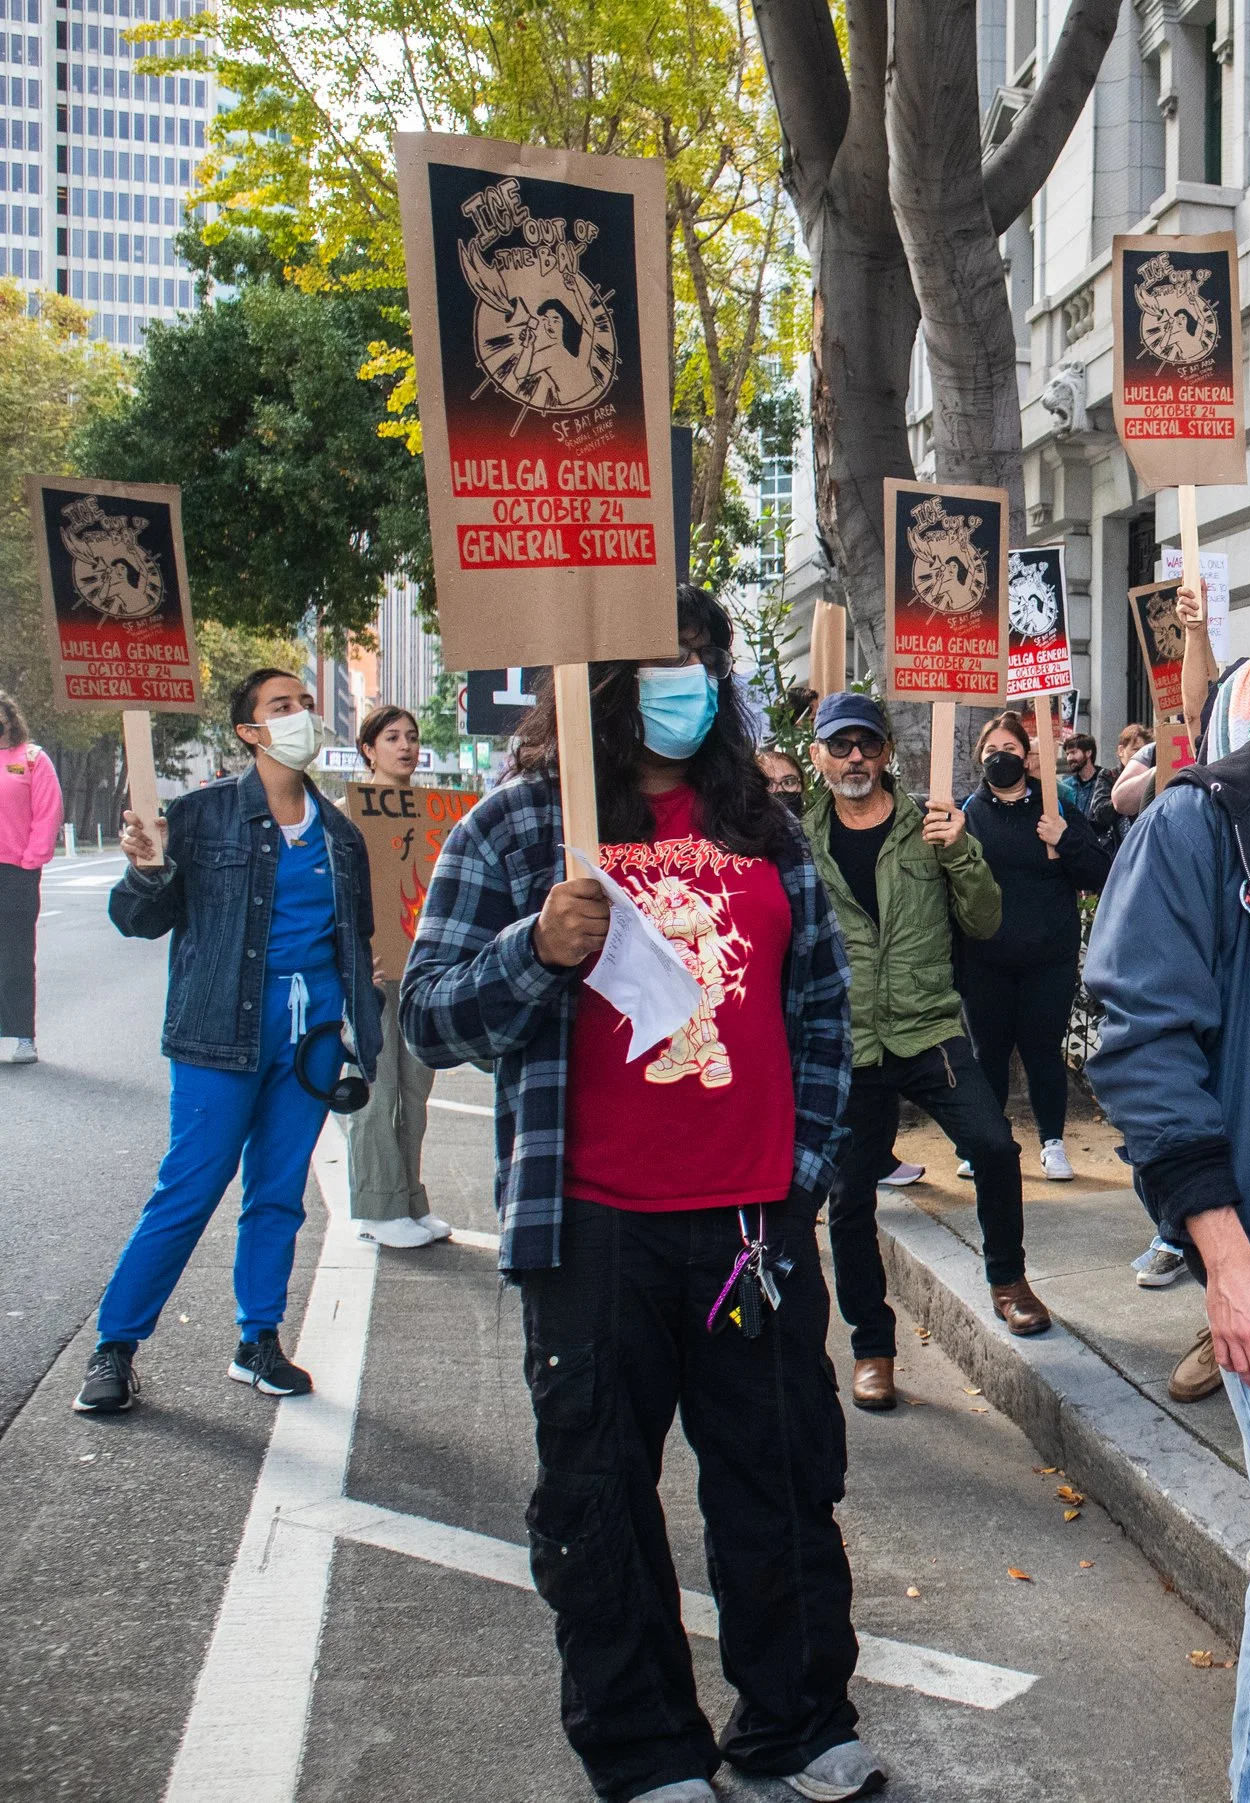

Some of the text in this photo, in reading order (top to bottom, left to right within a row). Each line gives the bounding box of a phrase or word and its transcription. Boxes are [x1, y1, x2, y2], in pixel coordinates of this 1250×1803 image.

[461, 177, 530, 250] ICE
[522, 218, 599, 246] OUT OF
[495, 241, 587, 277] THE BAY
[1137, 251, 1174, 289] ICE
[1168, 268, 1212, 285] OUT OF
[1177, 366, 1187, 378] SF
[1125, 386, 1234, 402] HUELGA GENERAL
[1144, 405, 1216, 418] OCTOBER 24
[552, 403, 616, 442] SF BAY AREA
[1127, 420, 1232, 436] GENERAL STRIKE
[565, 419, 614, 450] GENERAL STRIKE
[453, 459, 650, 491] HUELGA GENERAL
[60, 496, 105, 535] ICE
[492, 498, 624, 525] OCTOBER 24
[911, 496, 947, 532] ICE
[463, 529, 653, 563] GENERAL STRIKE
[122, 621, 134, 634] SF
[947, 617, 957, 628] SF
[61, 640, 189, 662] HUELGA GENERAL
[895, 635, 998, 656] HUELGA GENERAL
[914, 656, 982, 670] OCTOBER 24
[1008, 647, 1069, 667] UELGA GENERAL
[87, 662, 172, 678] OCTOBER 24
[1016, 663, 1061, 678] OCTOBER 24
[69, 678, 193, 699] GENERAL STRIKE
[896, 671, 997, 691] GENERAL STRIKE
[1007, 672, 1070, 693] GENERAL STRIKE
[392, 828, 414, 861] of
